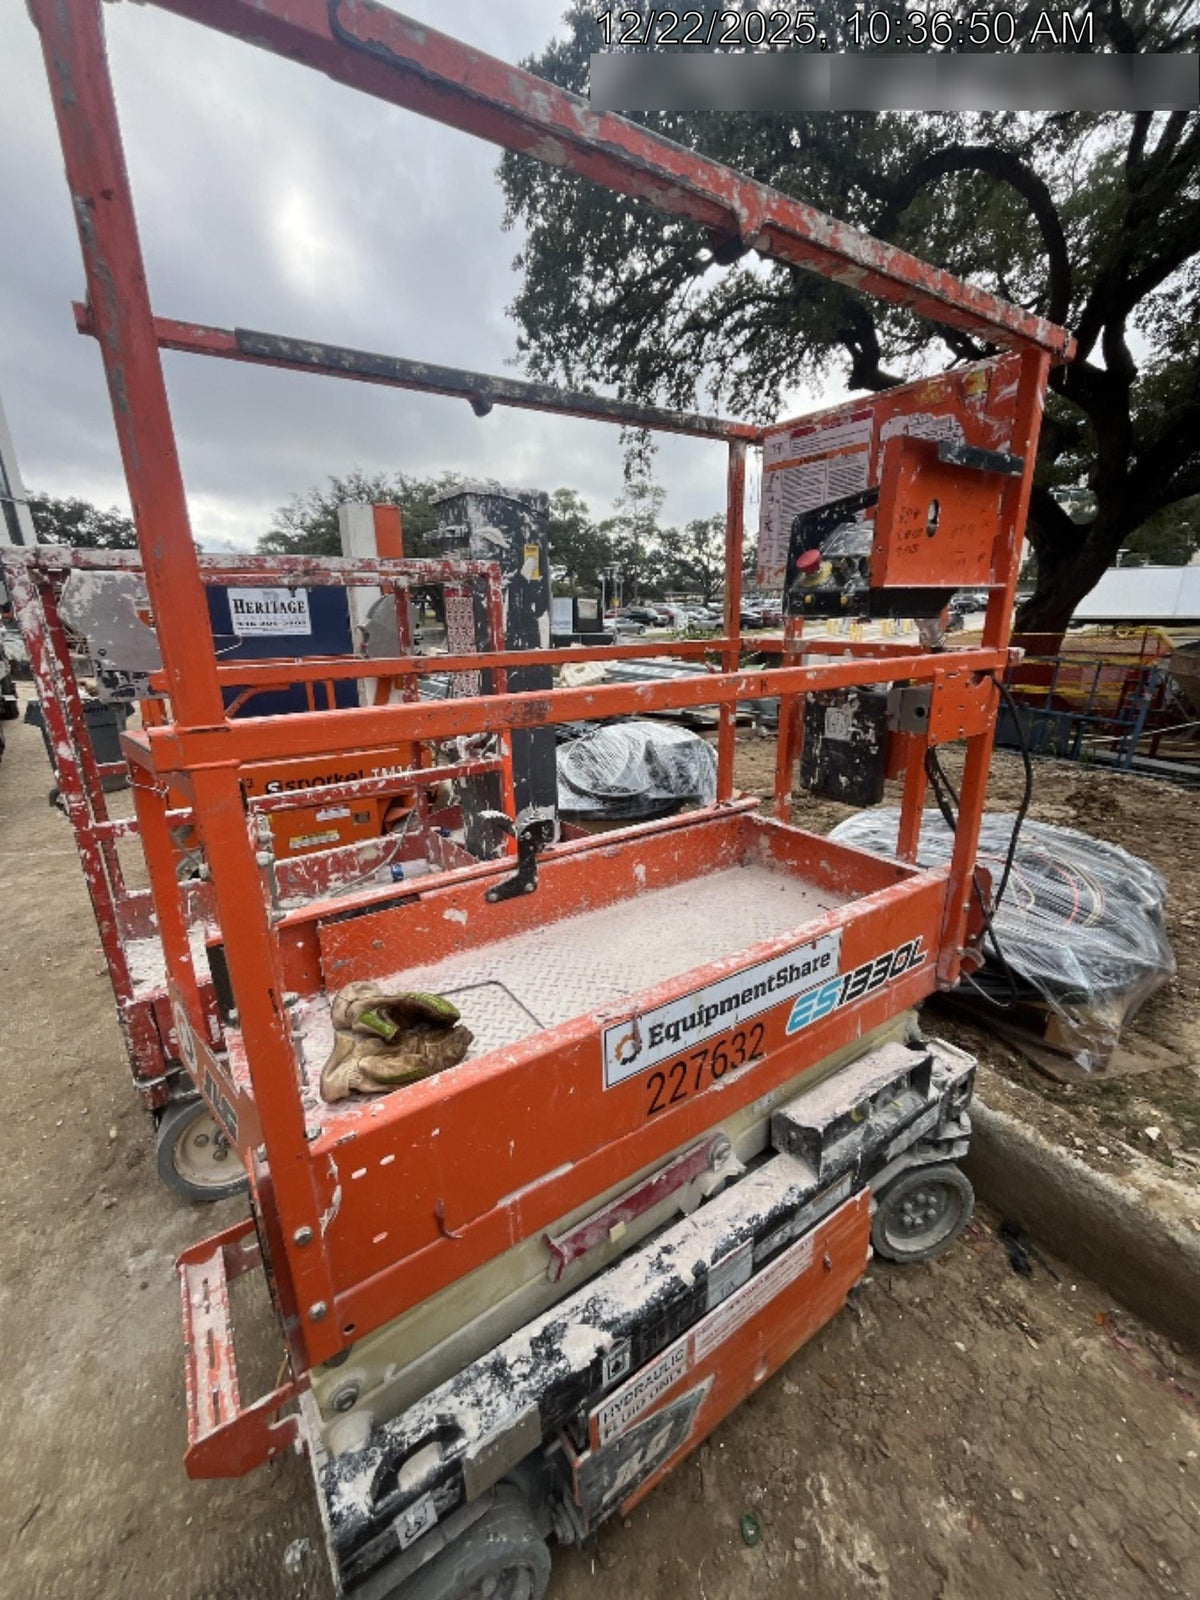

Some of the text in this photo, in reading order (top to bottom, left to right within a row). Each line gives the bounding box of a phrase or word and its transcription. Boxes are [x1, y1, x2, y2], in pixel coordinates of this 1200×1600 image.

[232, 598, 307, 614] HERITAGE
[647, 950, 831, 1050] EquipmentShare
[786, 935, 927, 1035] ES1330L
[646, 1022, 767, 1117] 227632
[603, 1348, 684, 1424] HYDRAULIC
